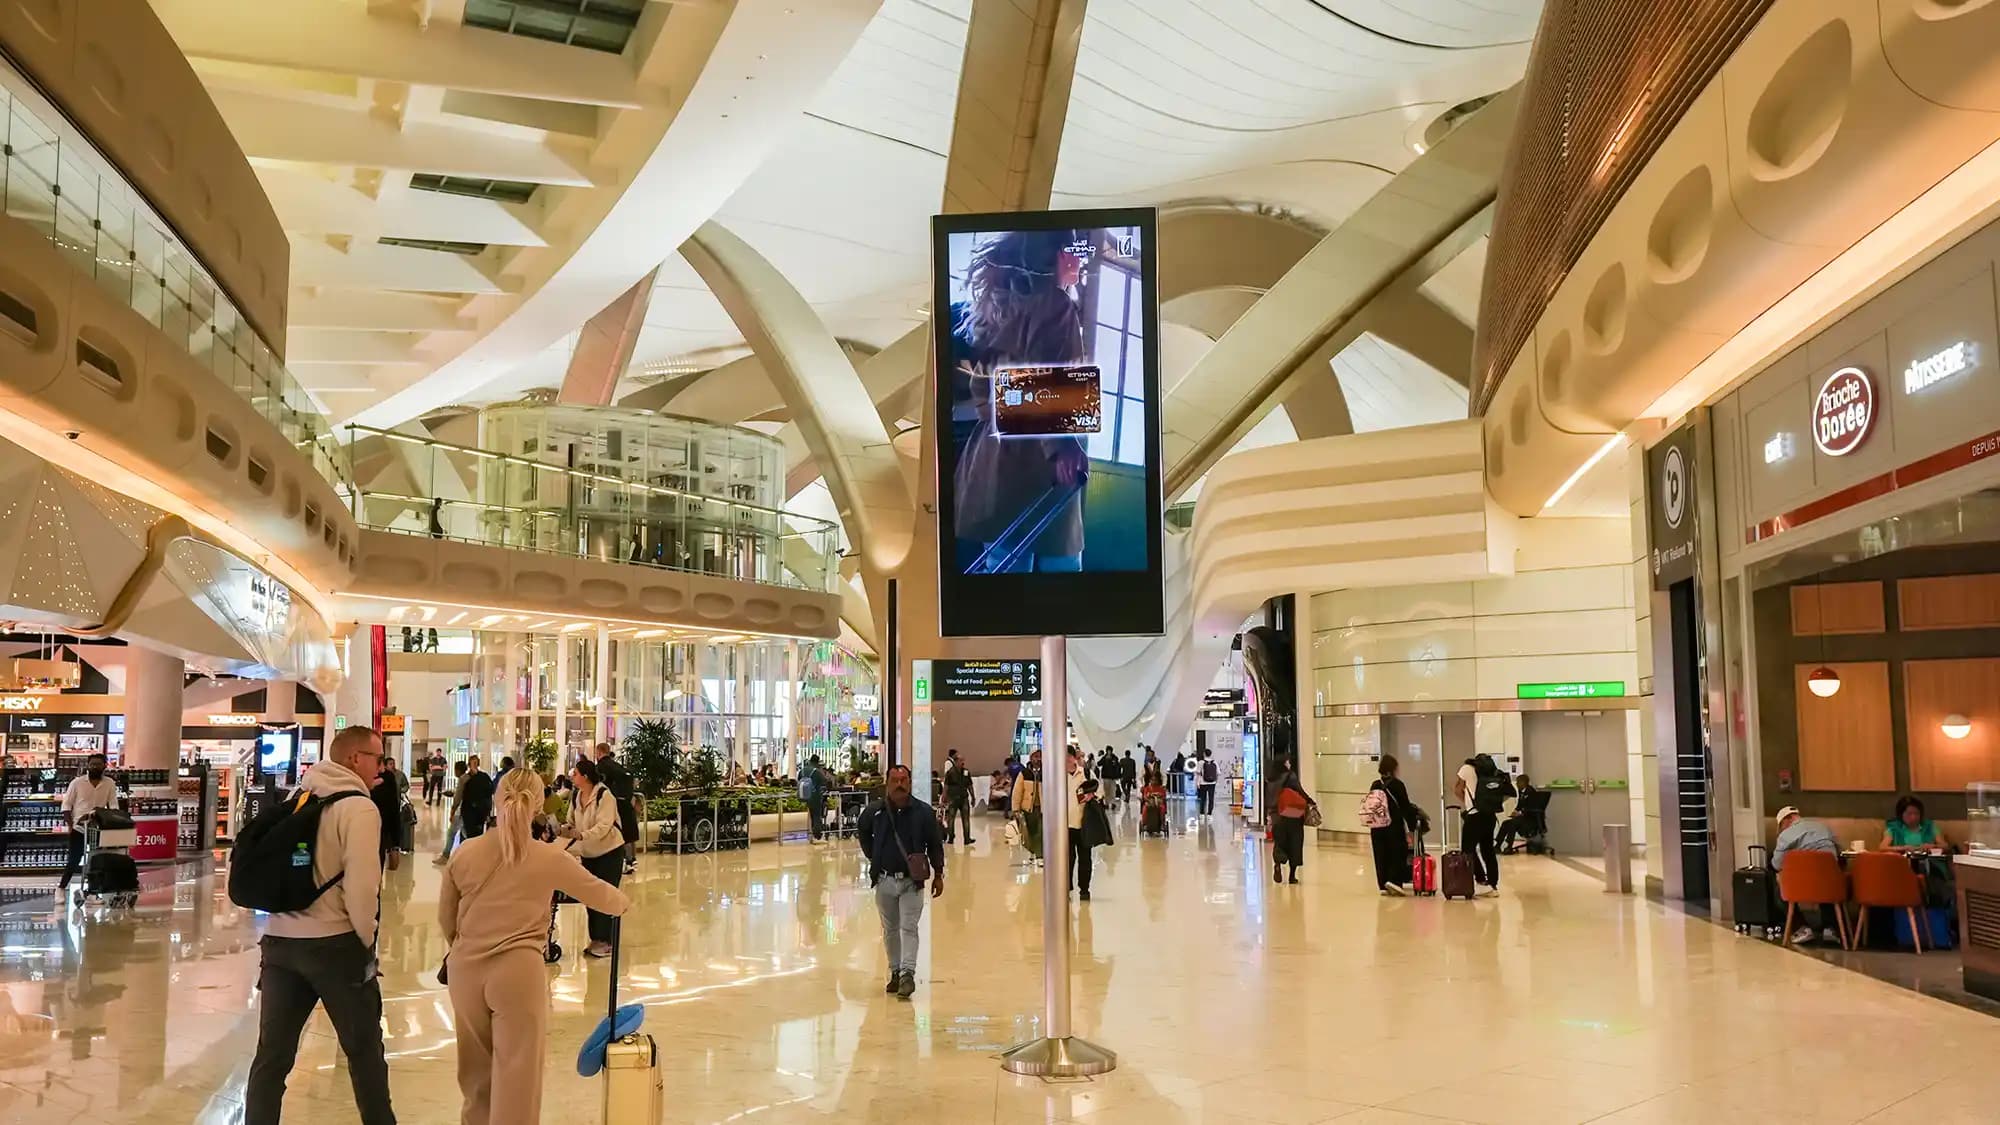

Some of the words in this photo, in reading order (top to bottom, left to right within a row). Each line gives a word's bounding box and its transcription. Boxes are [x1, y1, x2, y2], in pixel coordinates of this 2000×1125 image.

[1822, 379, 1860, 415] Brioche
[1075, 416, 1098, 426] VISA
[1820, 402, 1866, 444] Dorée
[1972, 438, 1996, 457] DEPUIS
[0, 696, 43, 710] HISKY
[251, 800, 259, 819] VELO
[144, 834, 167, 846] 20%
